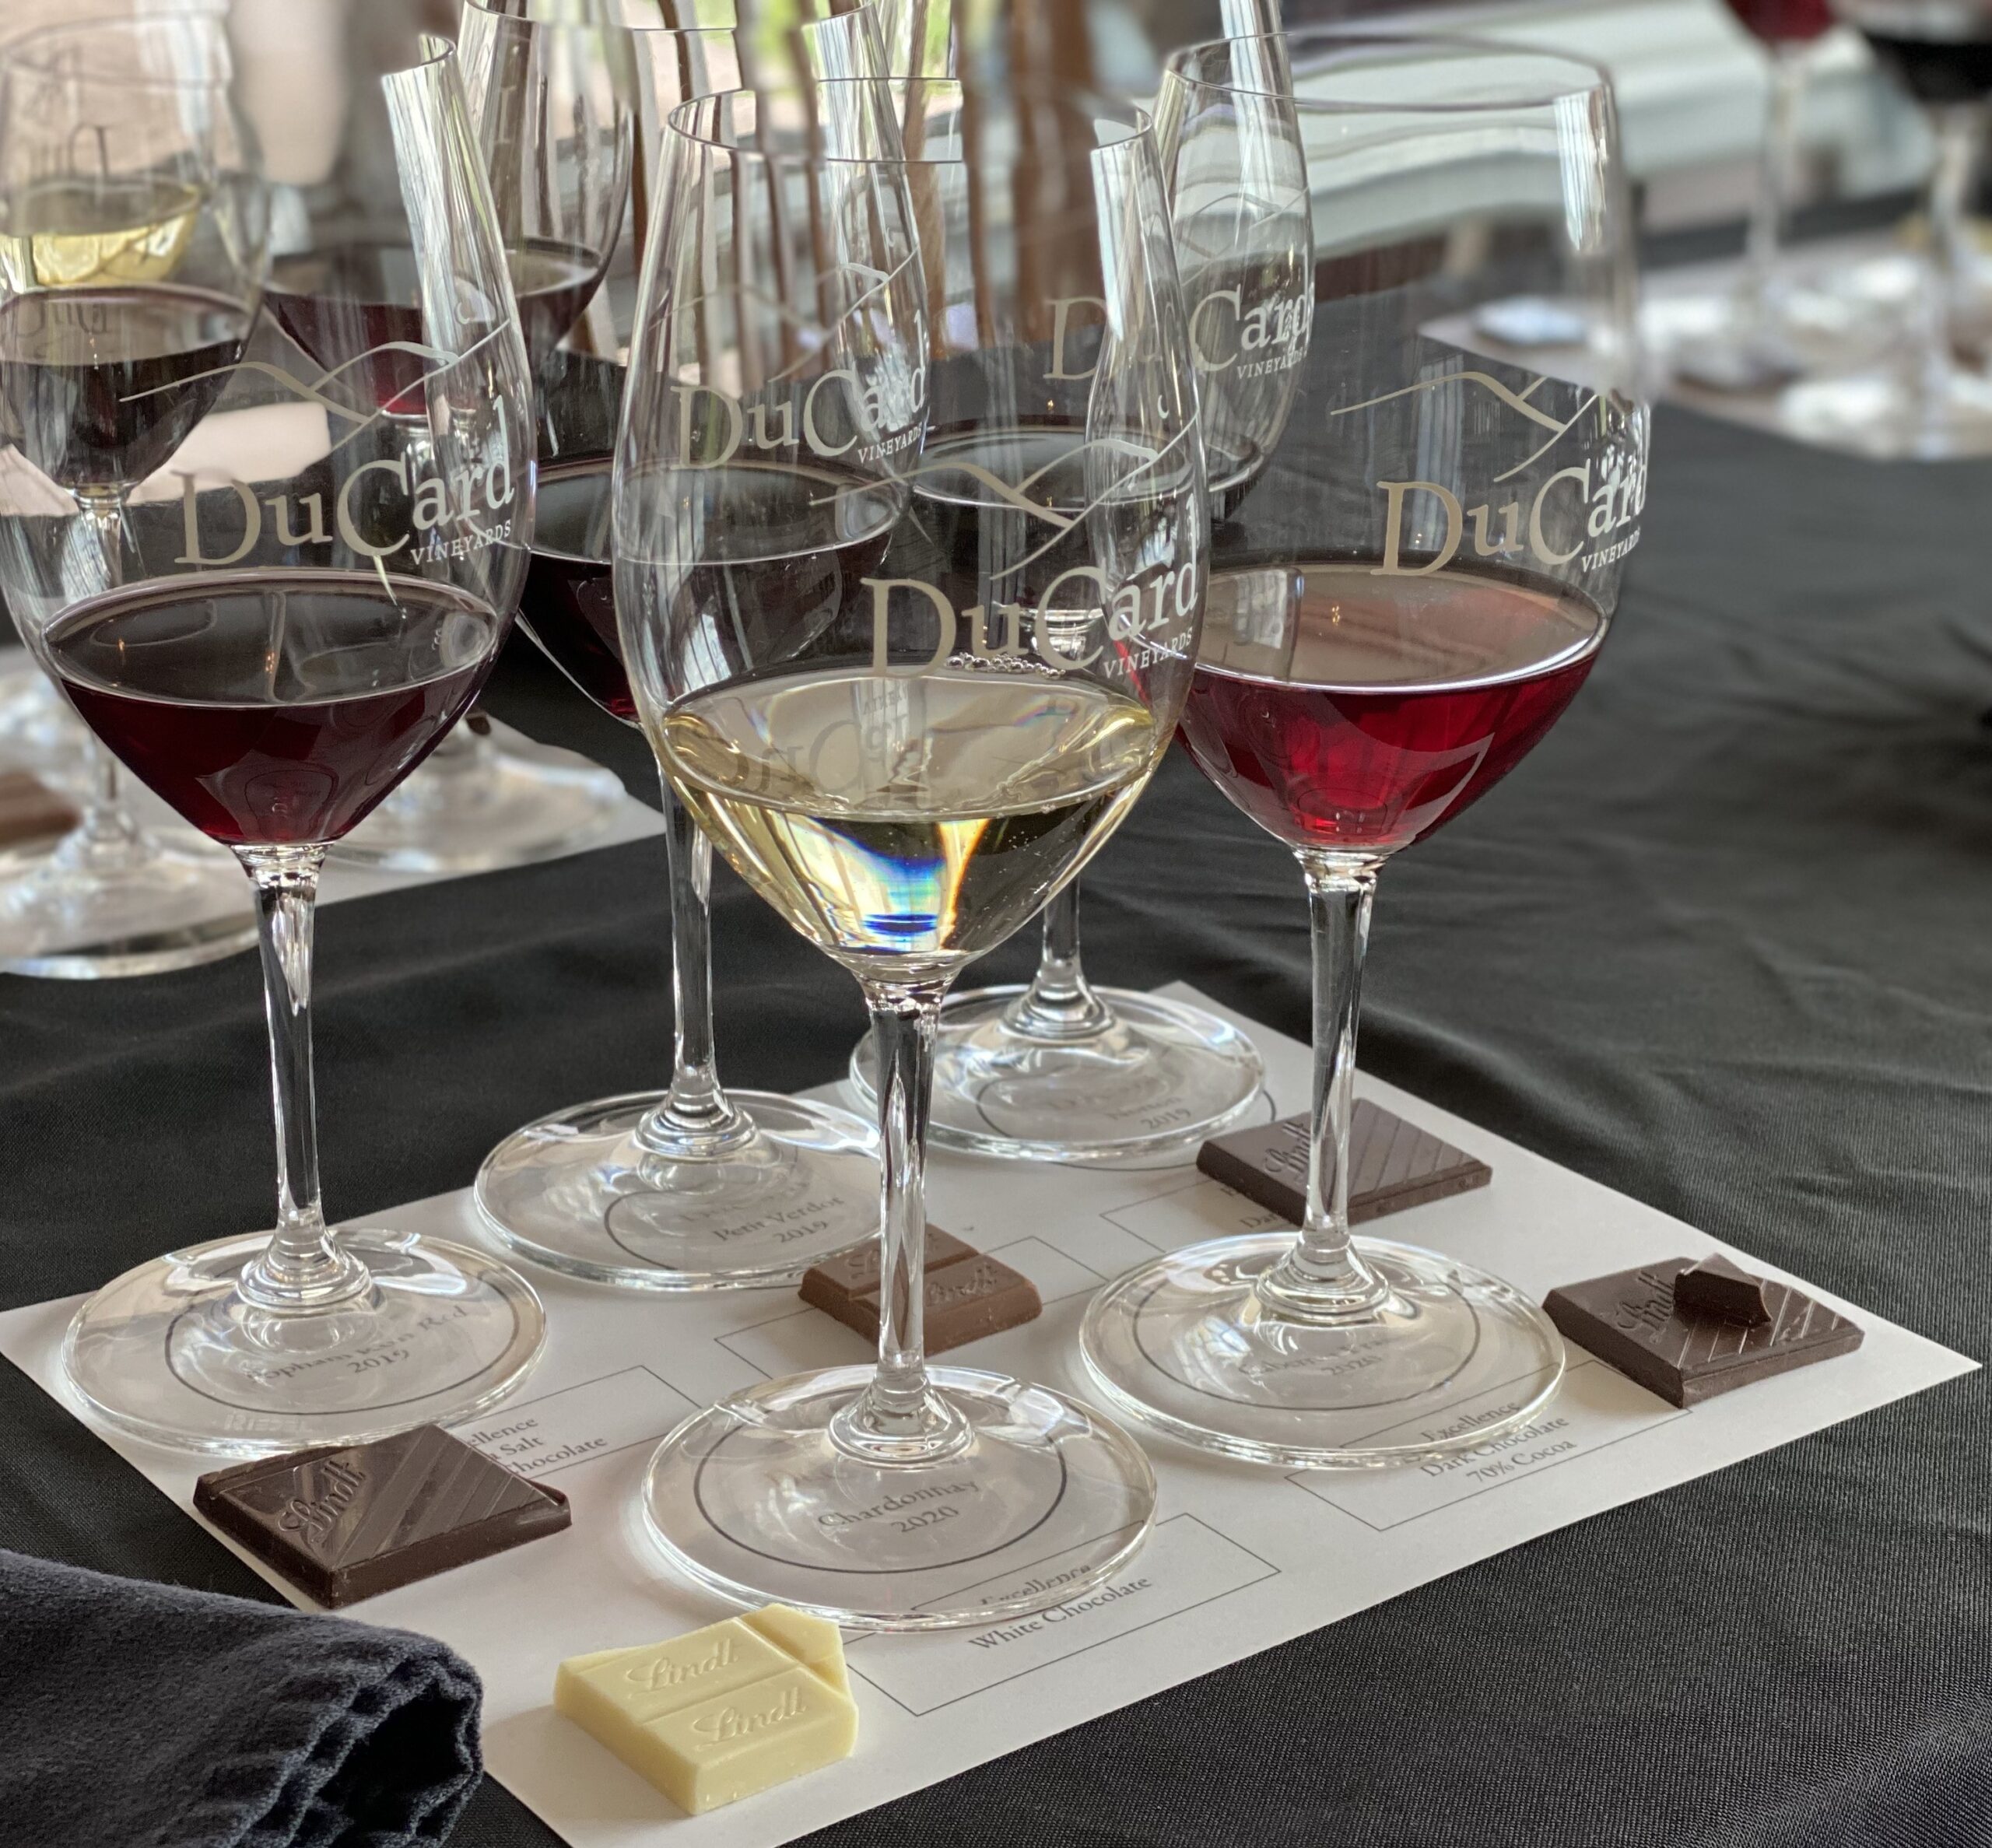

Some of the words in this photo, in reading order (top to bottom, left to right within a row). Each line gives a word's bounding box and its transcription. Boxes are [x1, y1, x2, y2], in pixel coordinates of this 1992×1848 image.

[670, 309, 925, 471] DuCad
[170, 394, 516, 566] DuCard
[1370, 406, 1650, 576] DuCard
[409, 518, 512, 566] VINEYARDS
[860, 493, 1198, 678] DuCard
[1103, 626, 1194, 679] VINEYARDS
[1140, 1108, 1191, 1129] 2019
[773, 1220, 829, 1243] 2019
[347, 1348, 410, 1374] 2019
[500, 1436, 545, 1457] Salt
[1420, 1452, 1475, 1478] Dark
[1474, 1416, 1570, 1457] Chocolate
[1421, 1401, 1520, 1443] Excellence
[1466, 1461, 1515, 1482] 70%
[1512, 1439, 1578, 1467] Cocoa
[278, 1460, 366, 1544] Lindt
[818, 1480, 980, 1527] Chardonnay
[891, 1504, 960, 1533] 2020
[968, 1620, 1043, 1650] White
[1042, 1576, 1153, 1624] Chocolate
[625, 1637, 740, 1700] Lindt
[691, 1686, 809, 1752] Lindt
